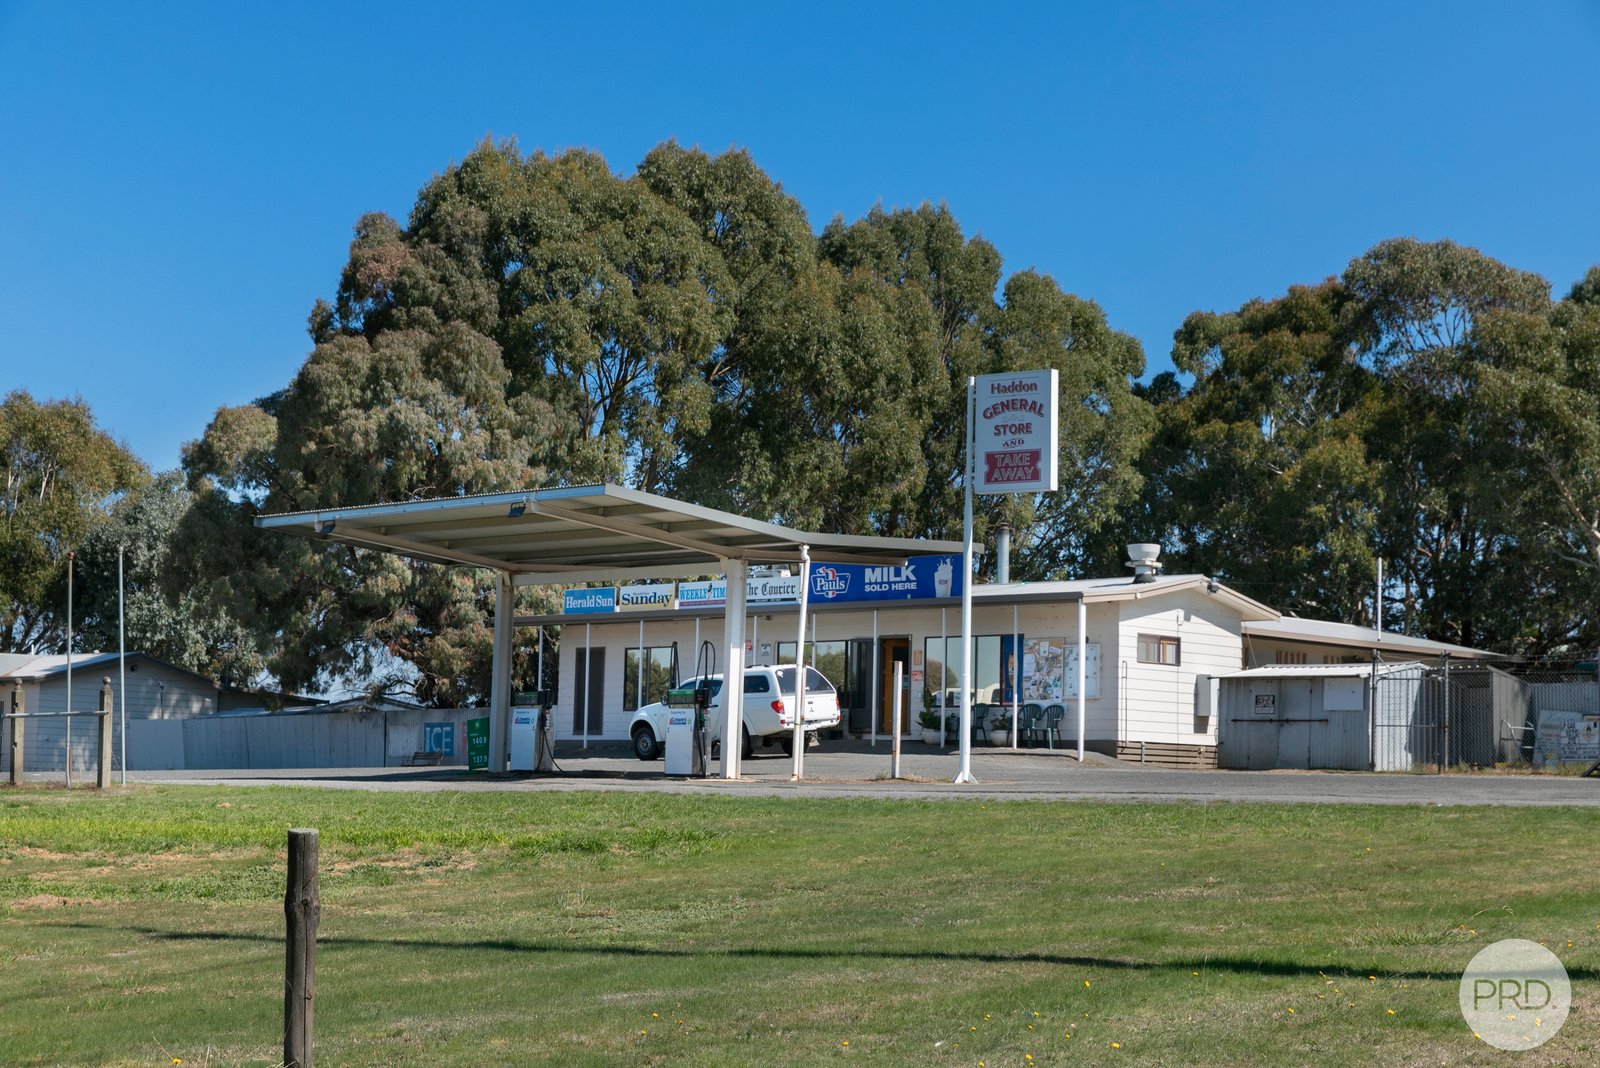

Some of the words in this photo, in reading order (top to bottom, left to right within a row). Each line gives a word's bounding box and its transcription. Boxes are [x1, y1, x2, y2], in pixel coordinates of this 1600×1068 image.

[990, 380, 1037, 394] Haddon
[983, 398, 1044, 420] GENERAL
[994, 423, 1032, 436] STORE
[1002, 439, 1025, 448] AND
[995, 453, 1031, 467] TAKE
[991, 467, 1034, 481] AWAY
[864, 565, 917, 583] MILK
[761, 582, 796, 598] Courier
[816, 578, 845, 591] Pauls
[864, 583, 889, 592] SOLD
[892, 582, 917, 591] HERE
[621, 592, 672, 607] Sunday
[680, 588, 707, 600] WEEKLY
[565, 595, 595, 608] Herald
[595, 595, 613, 607] Sun
[425, 726, 452, 753] ICE
